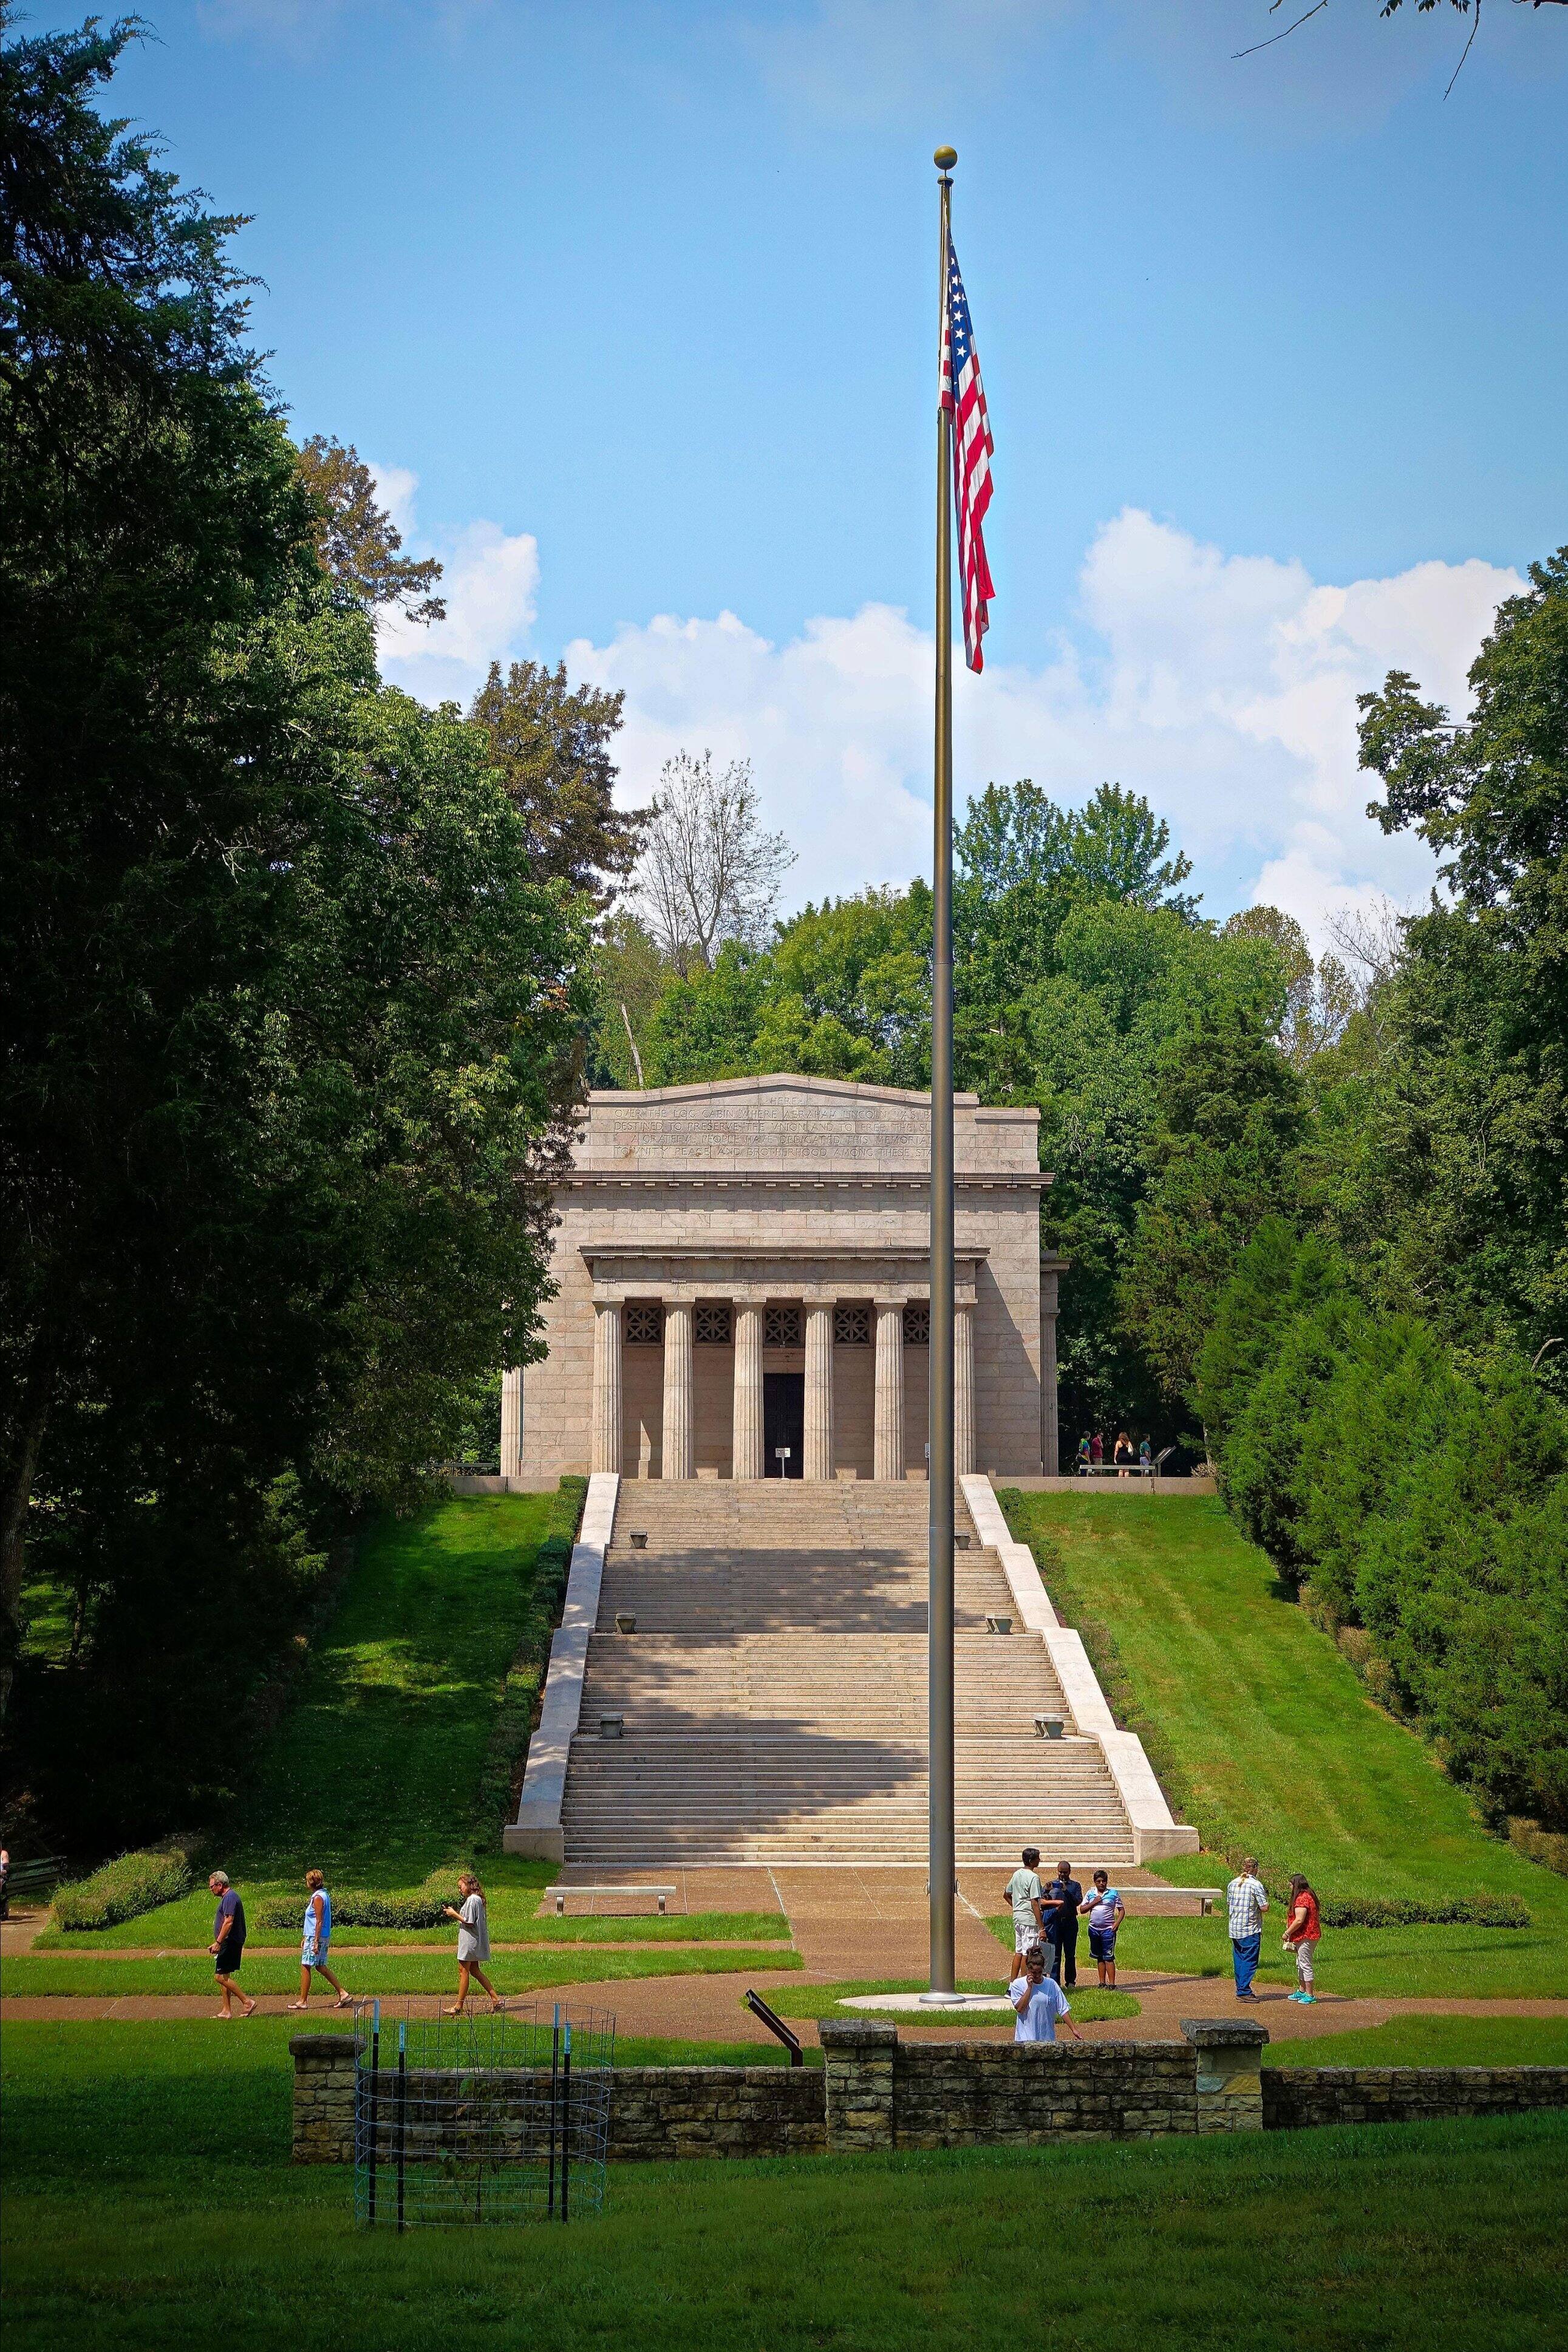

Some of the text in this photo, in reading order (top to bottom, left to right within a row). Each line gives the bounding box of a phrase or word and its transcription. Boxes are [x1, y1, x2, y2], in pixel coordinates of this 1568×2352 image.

[673, 1110, 696, 1118] LOG
[702, 1110, 734, 1118] CABIN
[740, 1110, 777, 1119] WHERE
[783, 1110, 836, 1119] ABRAHAM
[843, 1111, 887, 1119] LINCOLN
[615, 1122, 663, 1131] DESTINED
[668, 1122, 682, 1131] TO
[687, 1122, 739, 1131] PRESERVE
[745, 1122, 765, 1131] THE
[861, 1123, 886, 1132] FREE
[892, 1123, 913, 1132] THE
[631, 1134, 638, 1143] A
[703, 1135, 739, 1144] PEOPLE
[745, 1135, 773, 1144] HAVE
[780, 1136, 840, 1144] DEDICATED
[847, 1136, 868, 1145] THIS
[615, 1147, 629, 1156] TO
[675, 1147, 711, 1156] PEACE
[747, 1148, 827, 1156] BROTHERHOOD
[879, 1148, 910, 1157] THESE
